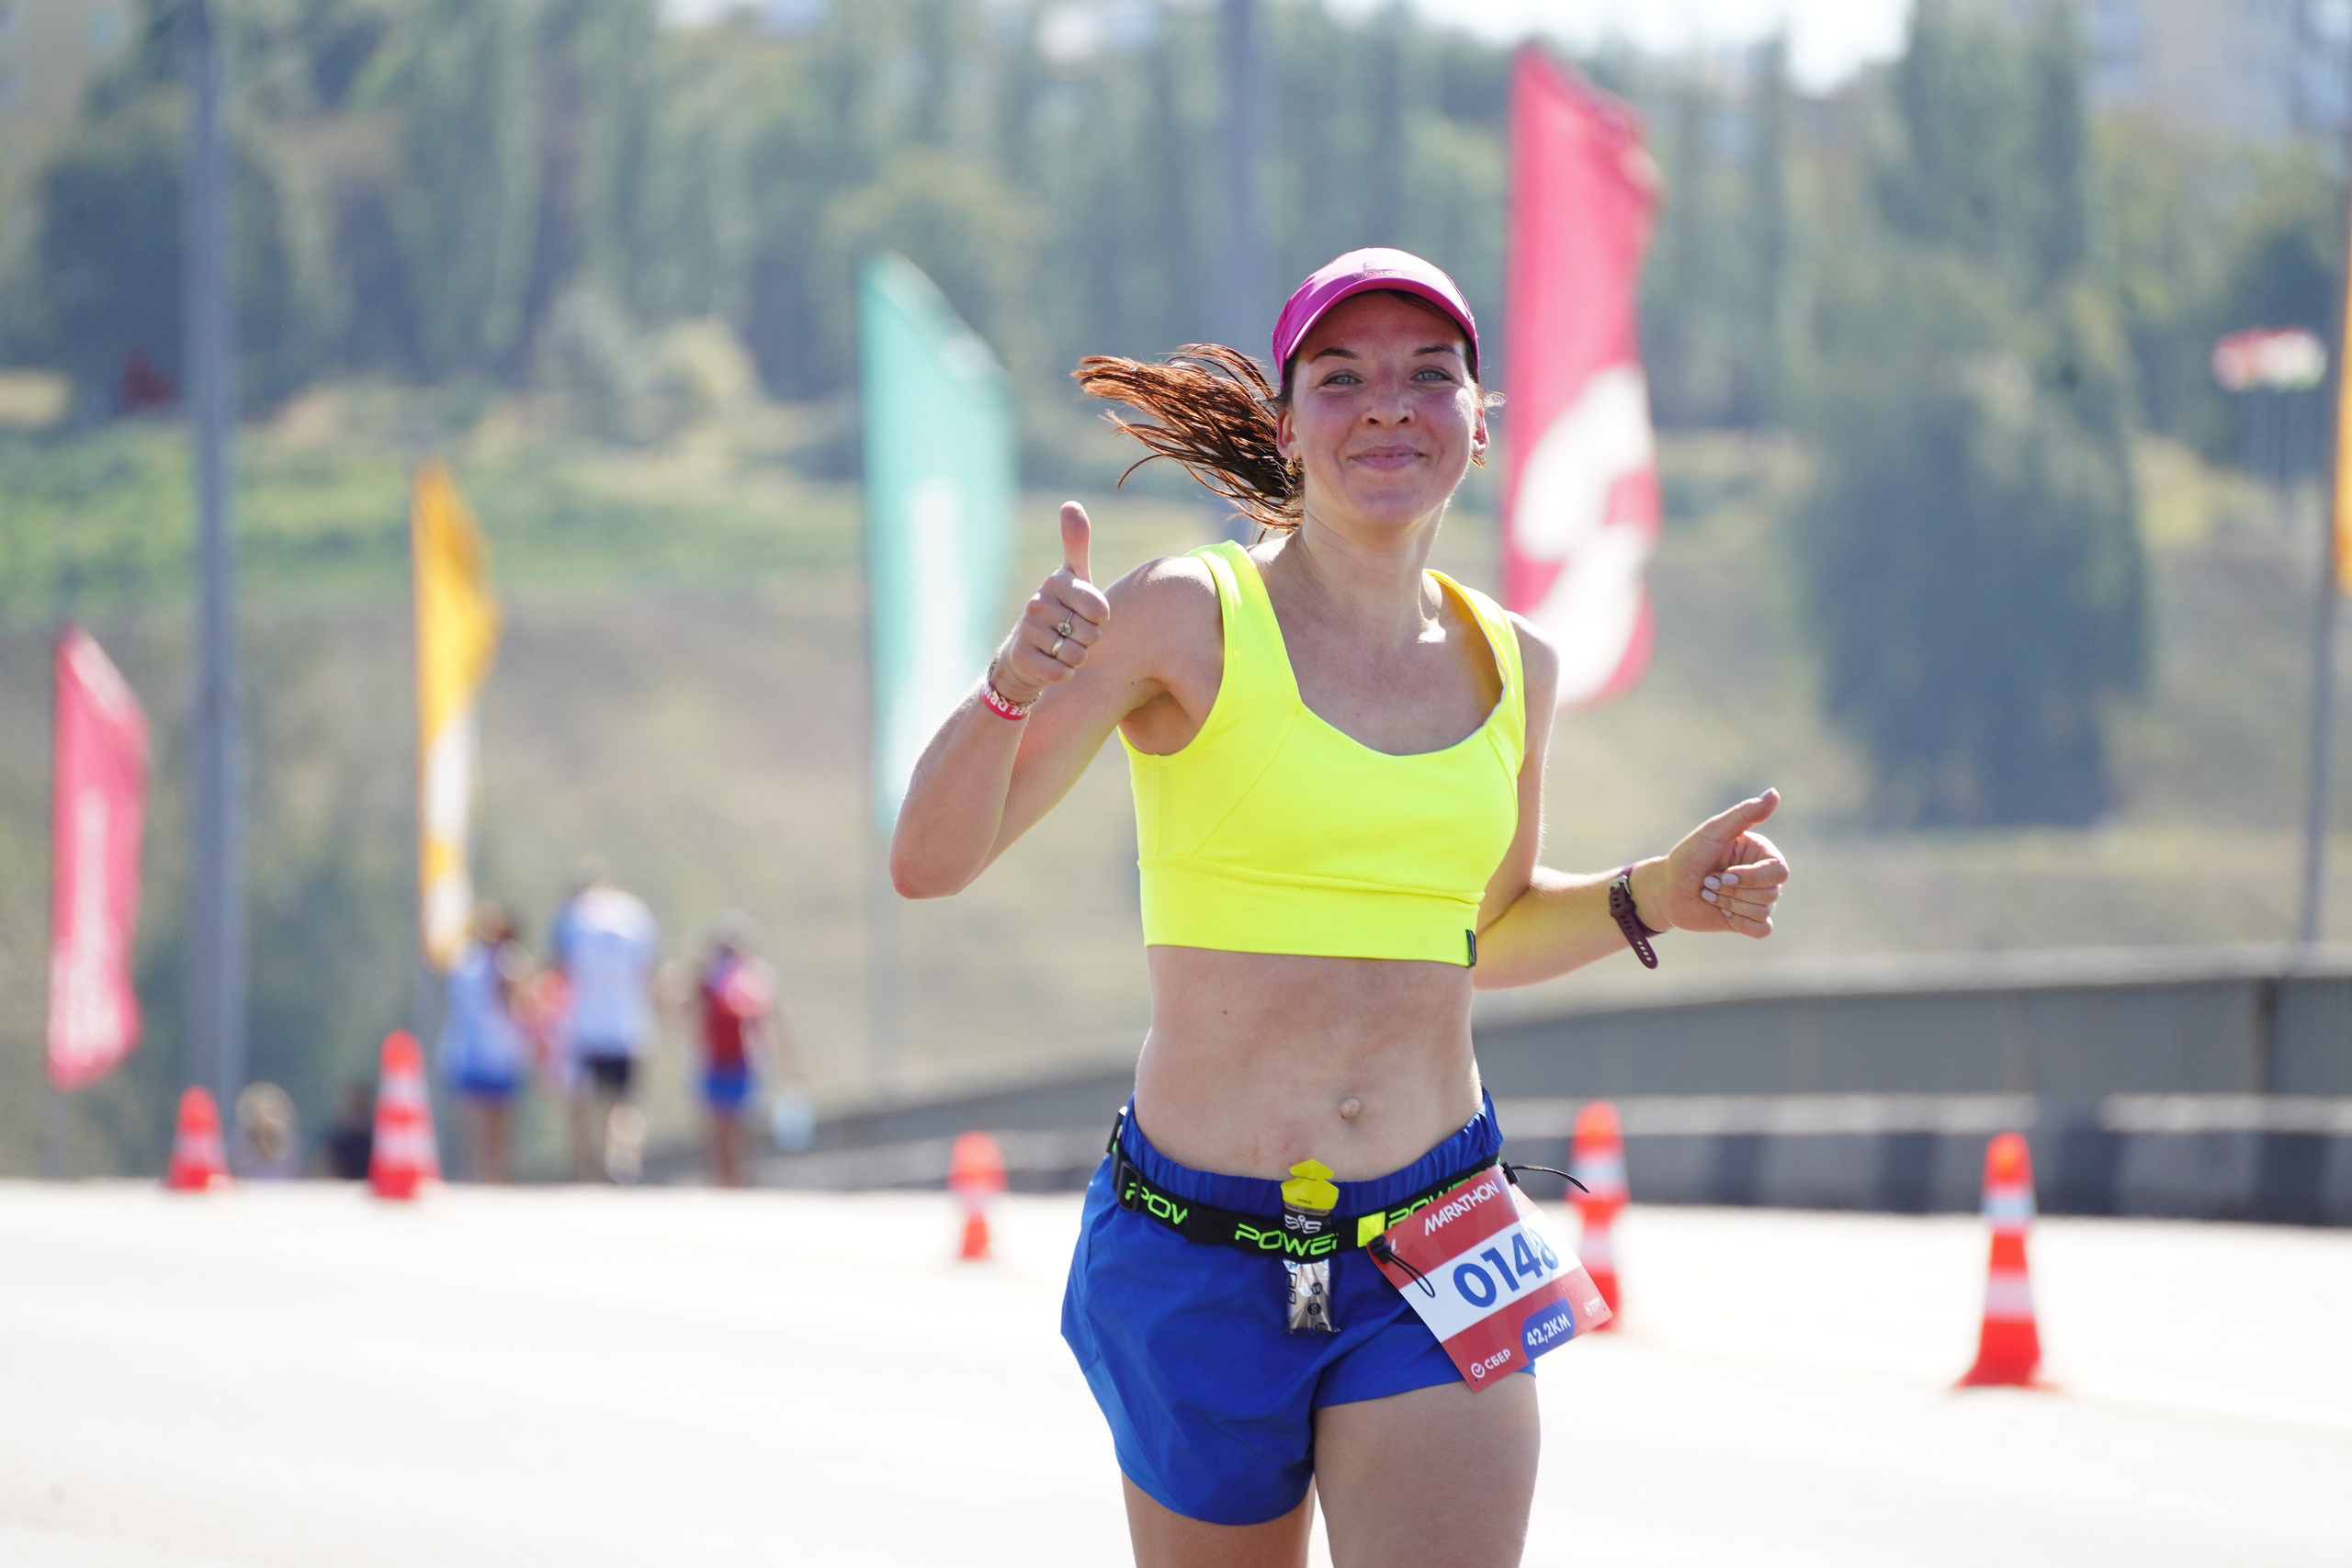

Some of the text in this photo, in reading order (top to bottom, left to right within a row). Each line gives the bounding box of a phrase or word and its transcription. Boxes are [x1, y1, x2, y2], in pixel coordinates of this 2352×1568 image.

[1424, 1179, 1501, 1237] MARATHON
[1525, 1313, 1572, 1348] 42,2KM
[1484, 1348, 1511, 1371] СБЕР
